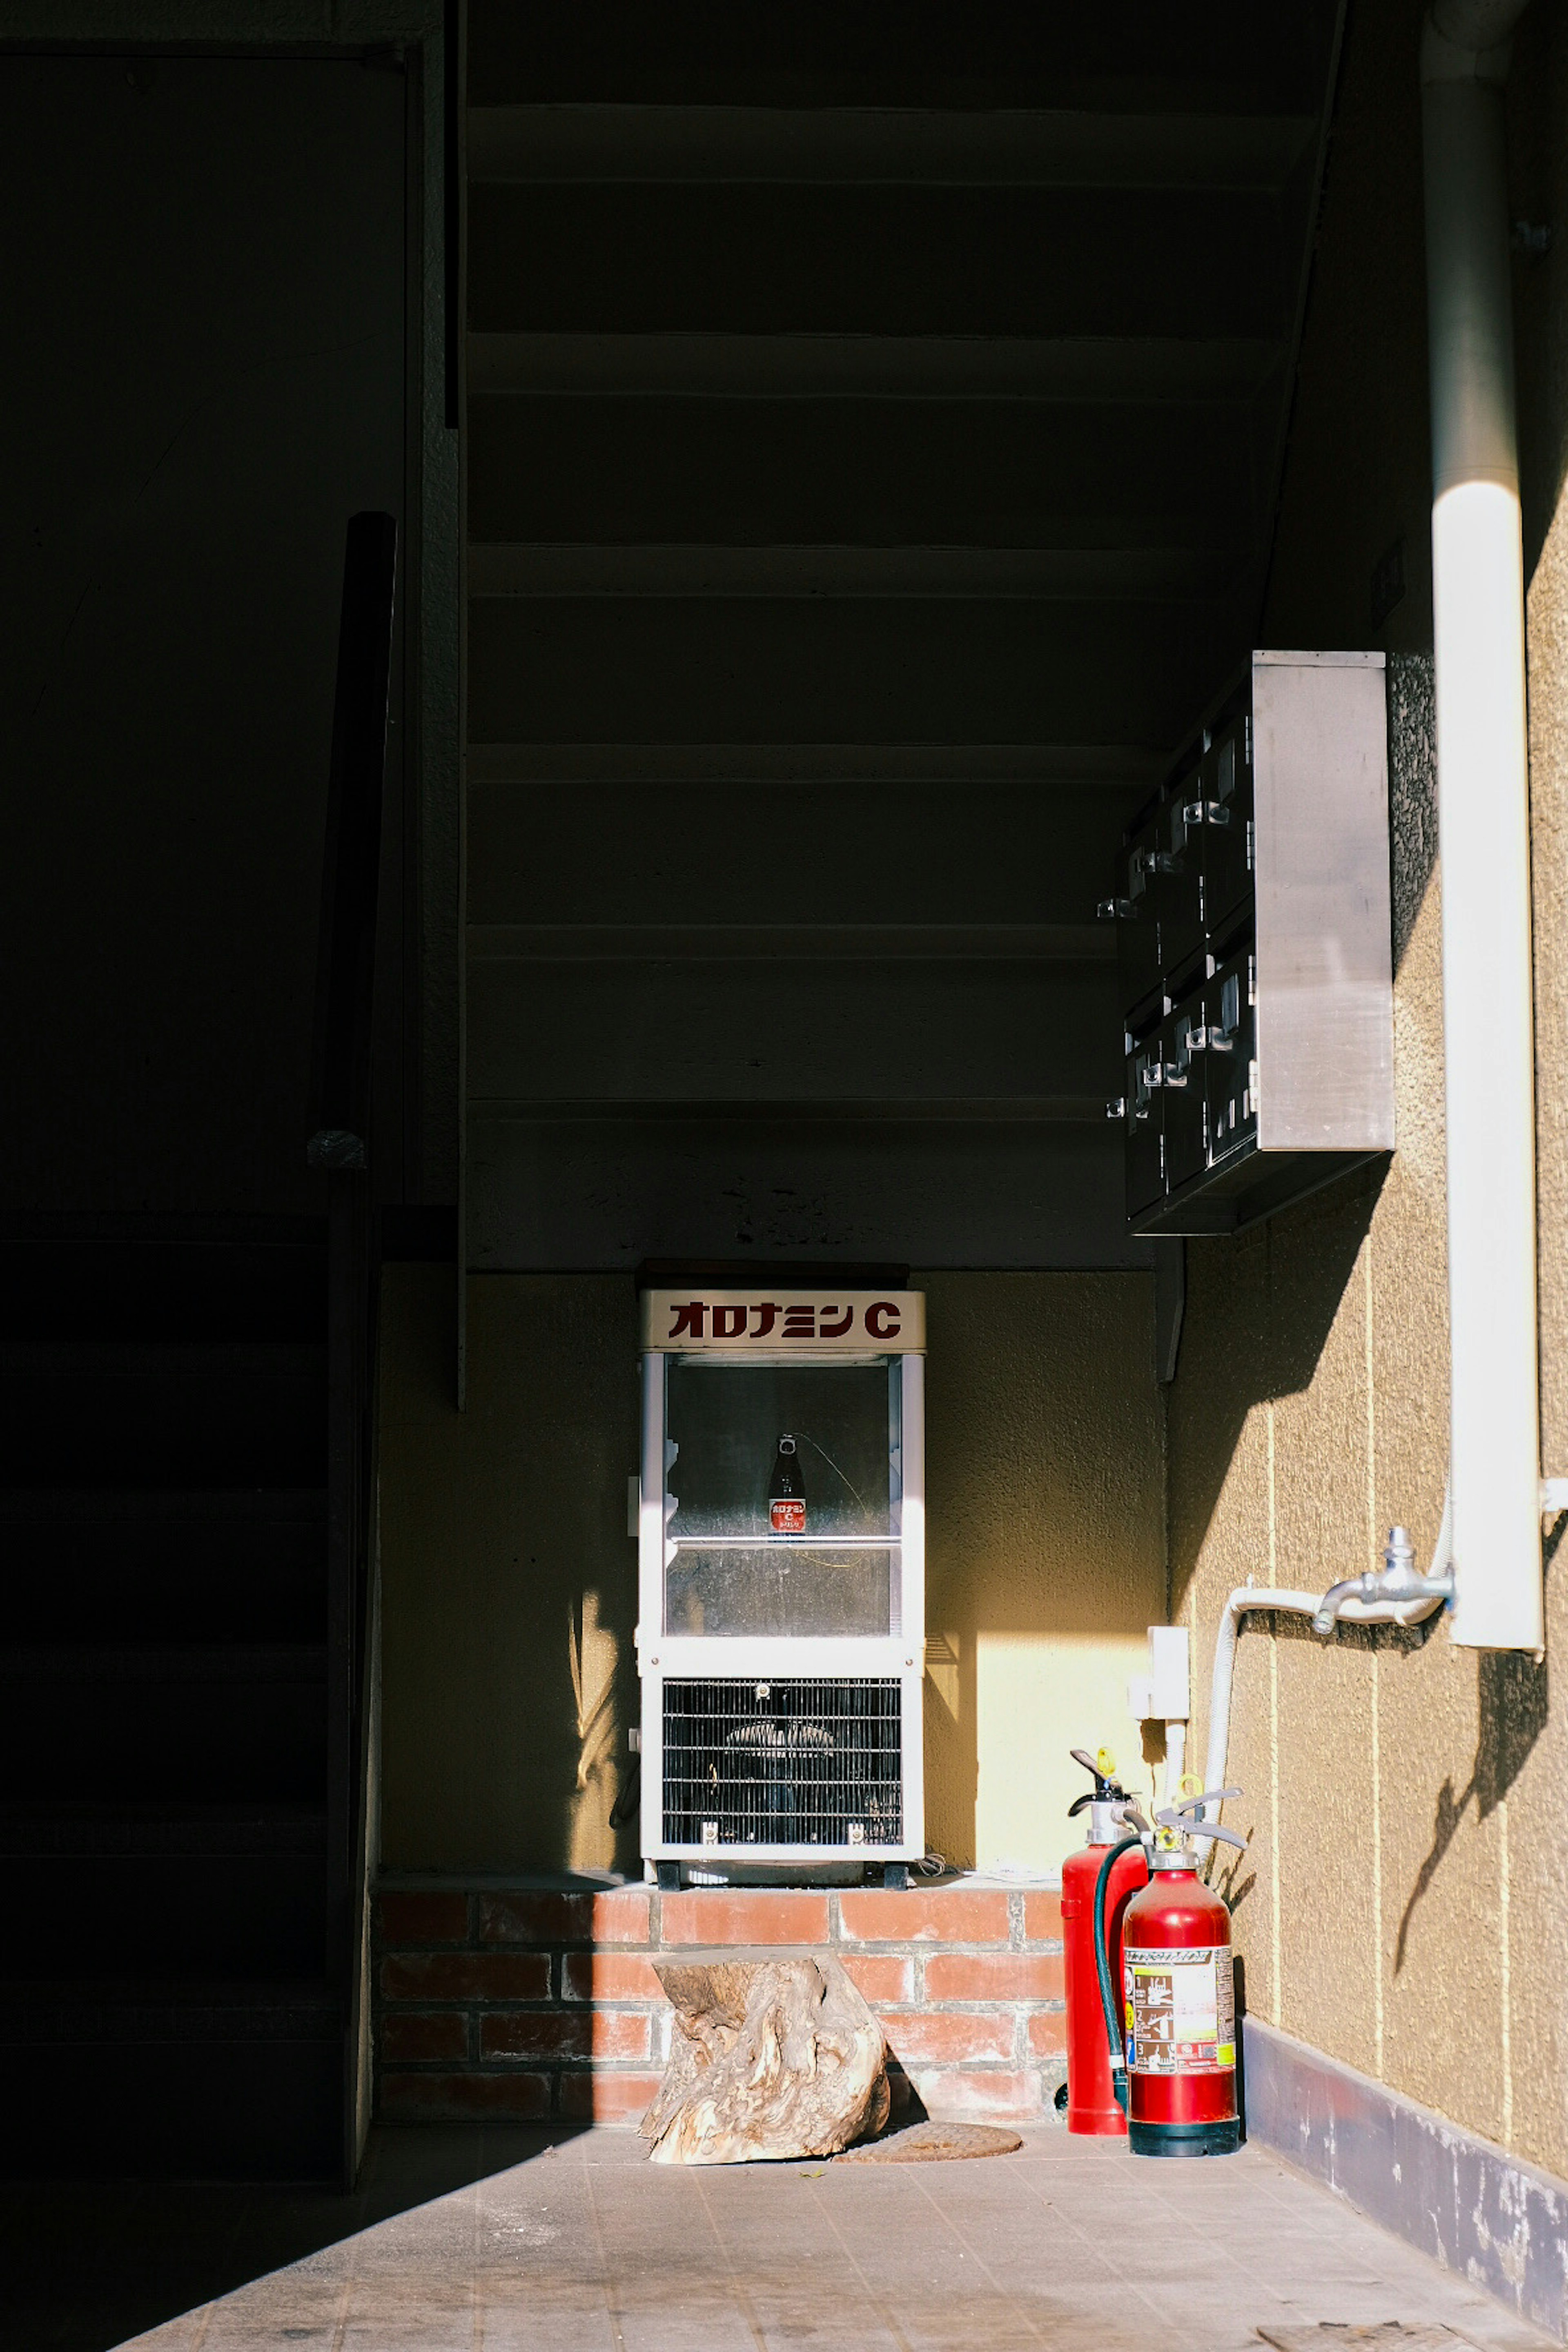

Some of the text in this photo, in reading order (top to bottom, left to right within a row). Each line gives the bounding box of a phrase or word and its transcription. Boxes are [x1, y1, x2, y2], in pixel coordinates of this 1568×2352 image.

[1136, 1976, 1141, 1987] 1
[1137, 2009, 1143, 2022] 2
[1138, 2043, 1144, 2055] 3
